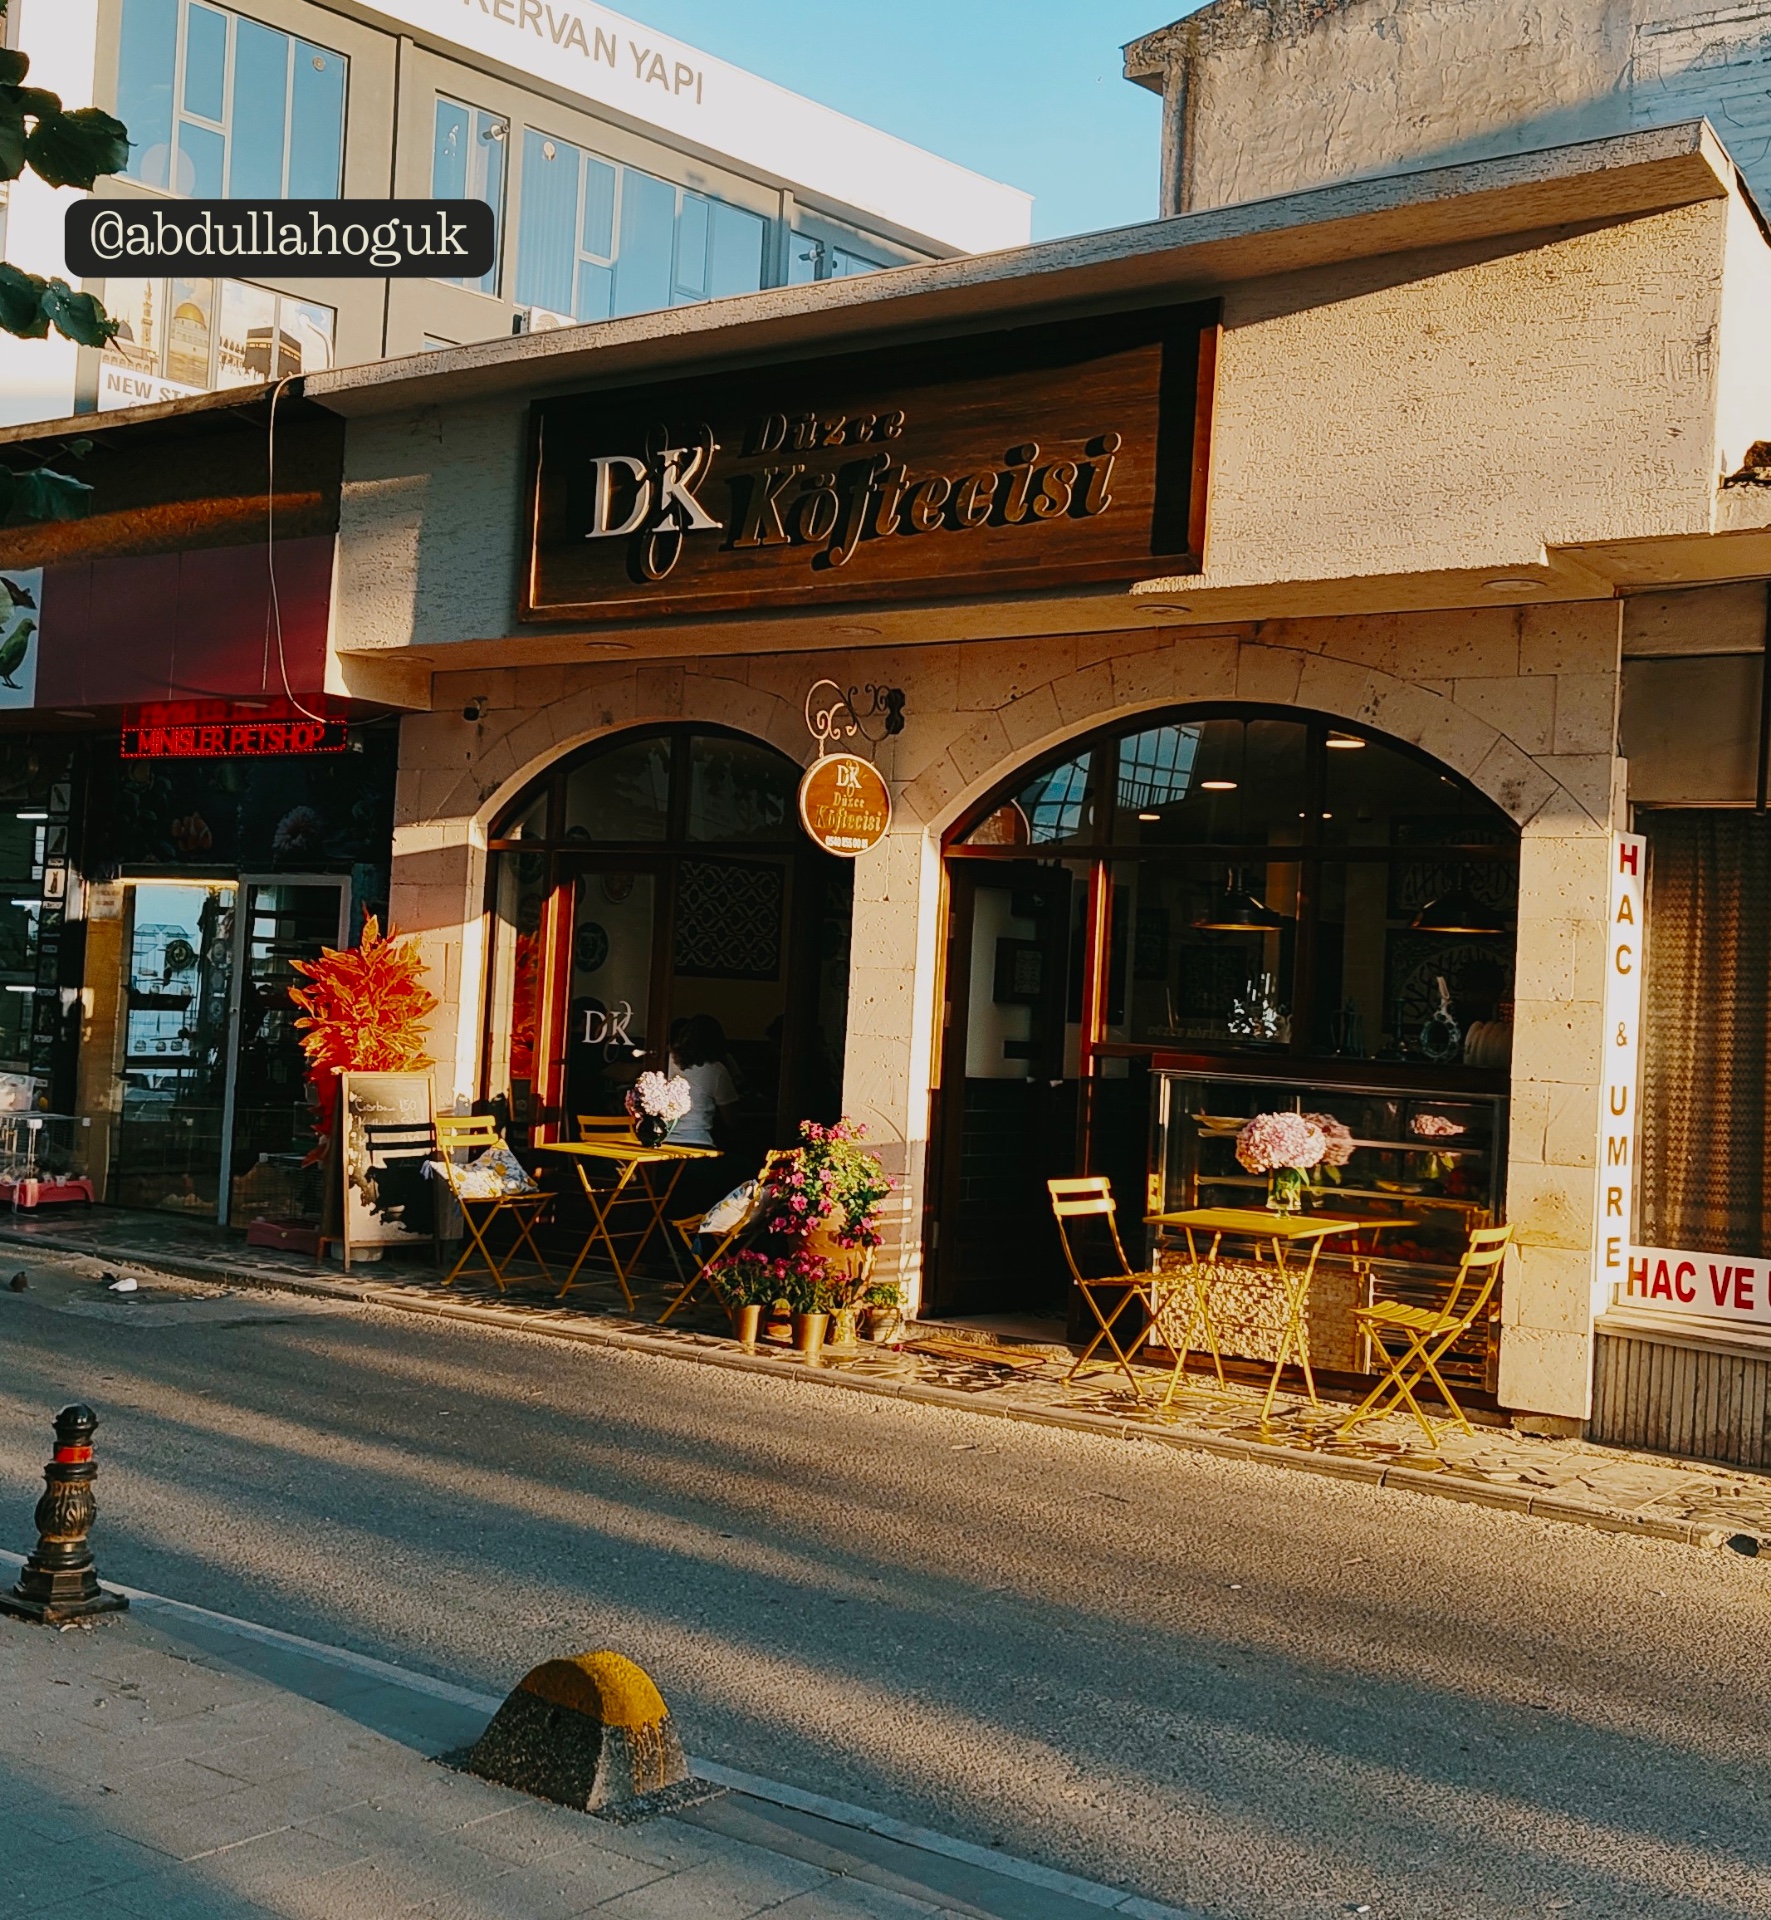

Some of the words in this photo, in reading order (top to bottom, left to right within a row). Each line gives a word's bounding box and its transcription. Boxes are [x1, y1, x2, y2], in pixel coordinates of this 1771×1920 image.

[628, 41, 703, 105] YAPI
[107, 373, 153, 399] NEW
[159, 387, 193, 402] ST
[752, 410, 905, 455] Düzce
[585, 438, 723, 545] DK
[734, 432, 1122, 566] Köftecisi
[230, 725, 325, 752] PETSHOP
[815, 805, 882, 834] Köftecisi
[833, 791, 865, 808] Düzce
[1615, 843, 1638, 975] HAC
[1616, 1021, 1628, 1047] &
[1606, 1085, 1628, 1268] UMRE
[1627, 1256, 1697, 1303] HAC
[1708, 1264, 1755, 1310] VE
